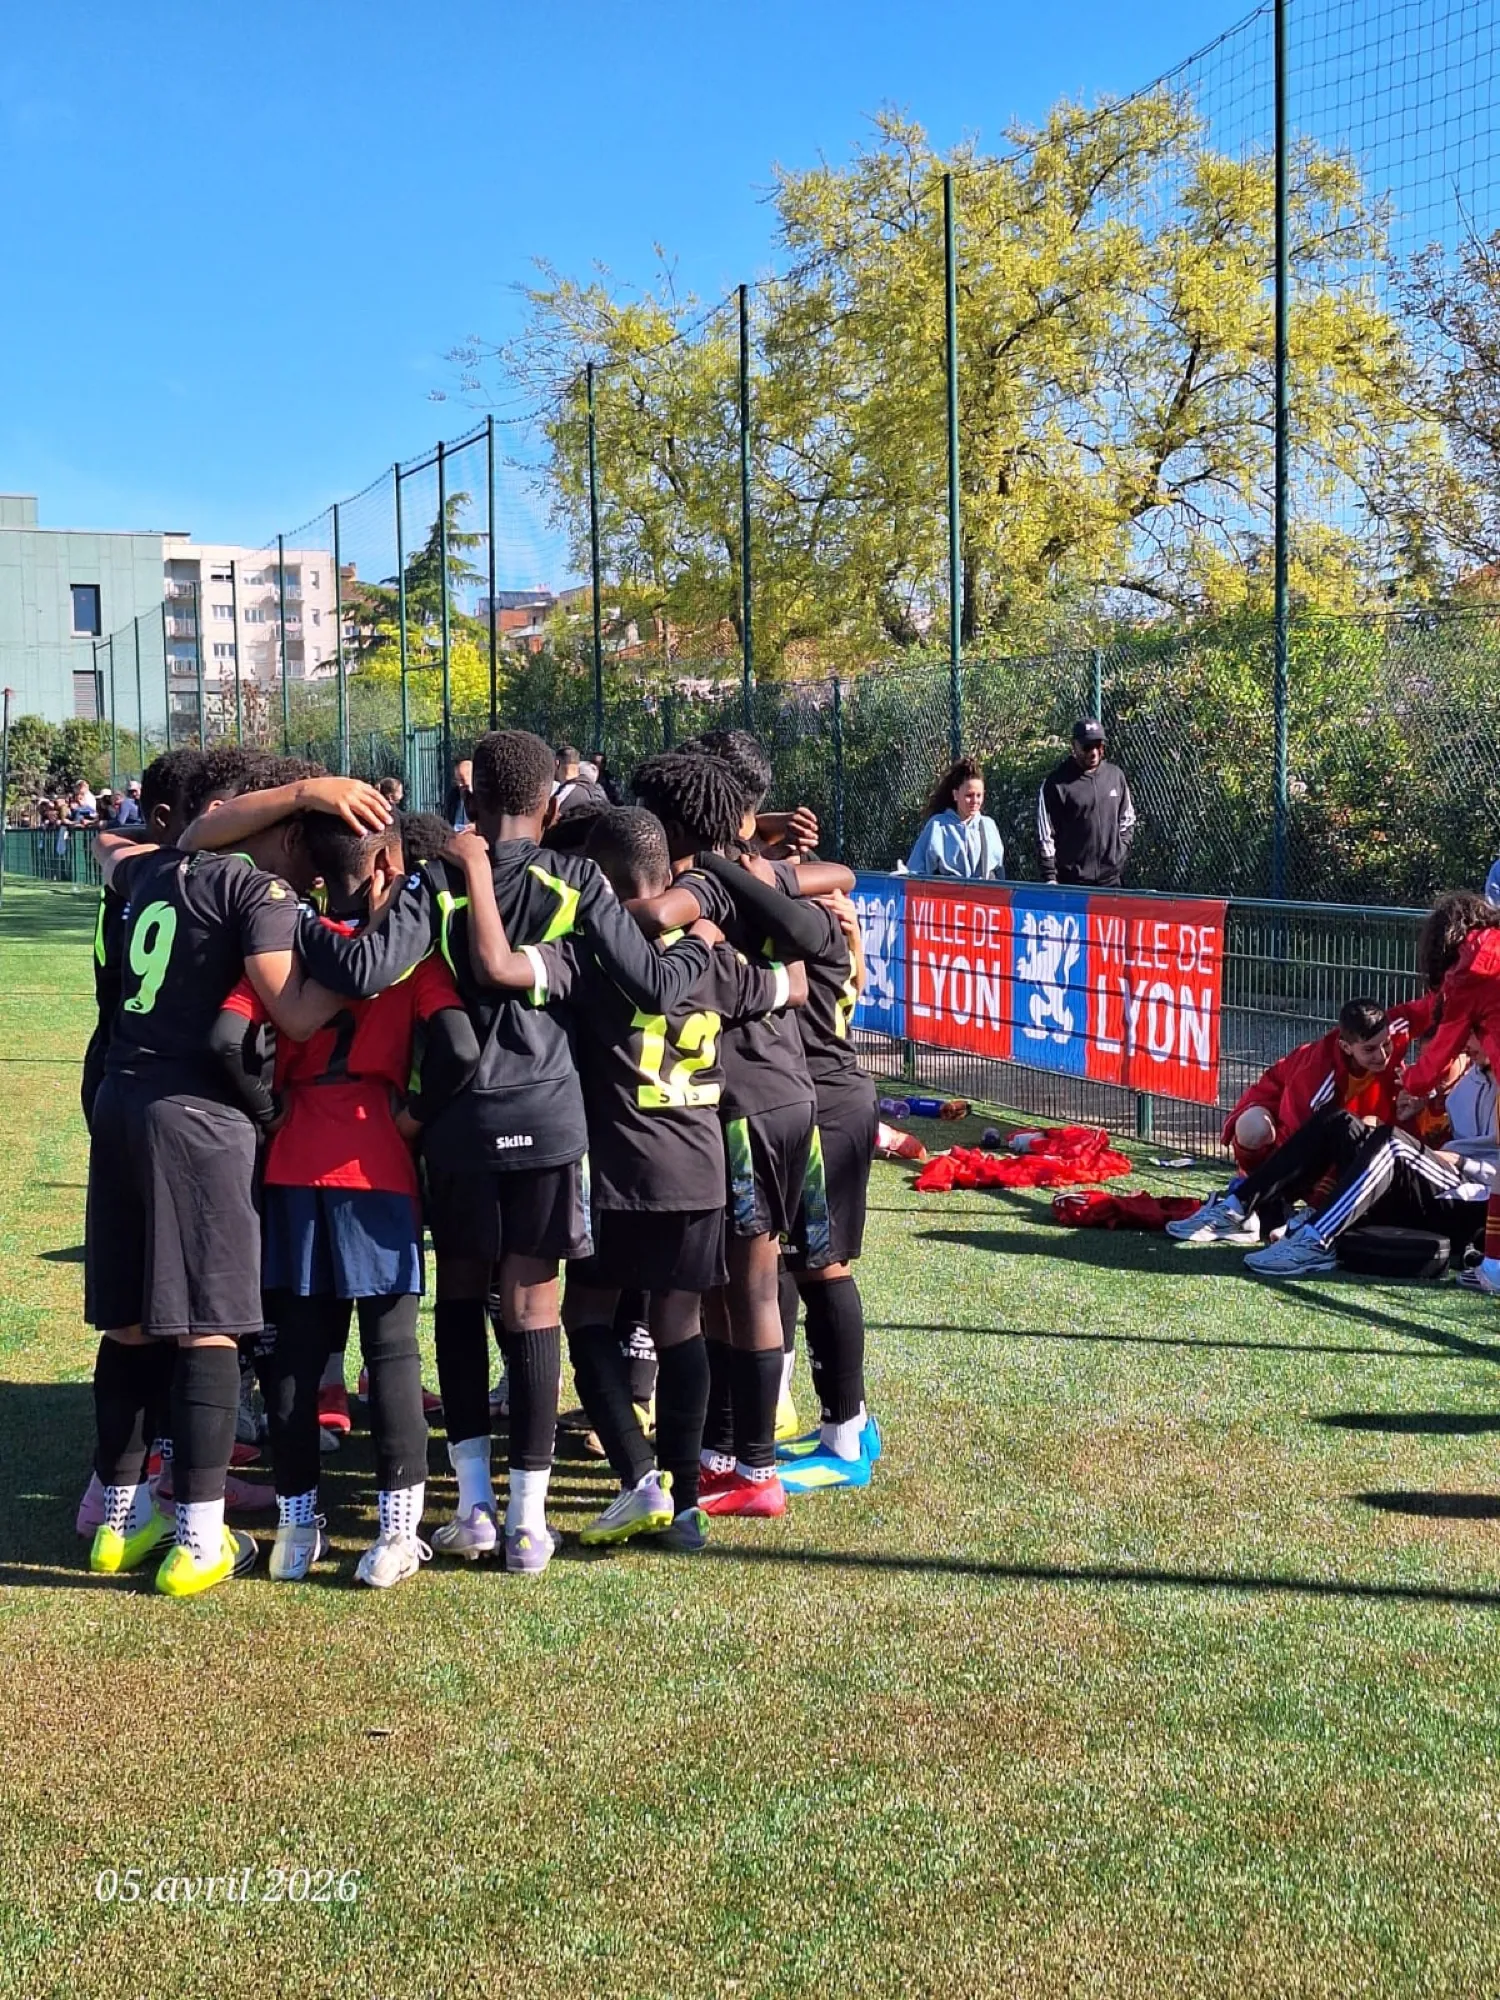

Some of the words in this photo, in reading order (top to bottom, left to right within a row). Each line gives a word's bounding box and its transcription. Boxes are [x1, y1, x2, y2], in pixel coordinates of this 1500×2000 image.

[124, 901, 177, 1014] 9
[911, 899, 967, 945] VILLE
[973, 905, 1001, 949] DE
[1096, 915, 1171, 969] VILLE
[1178, 924, 1216, 974] DE
[911, 950, 1001, 1032] LYON
[1095, 974, 1213, 1071] LYON
[631, 1010, 721, 1107] 12
